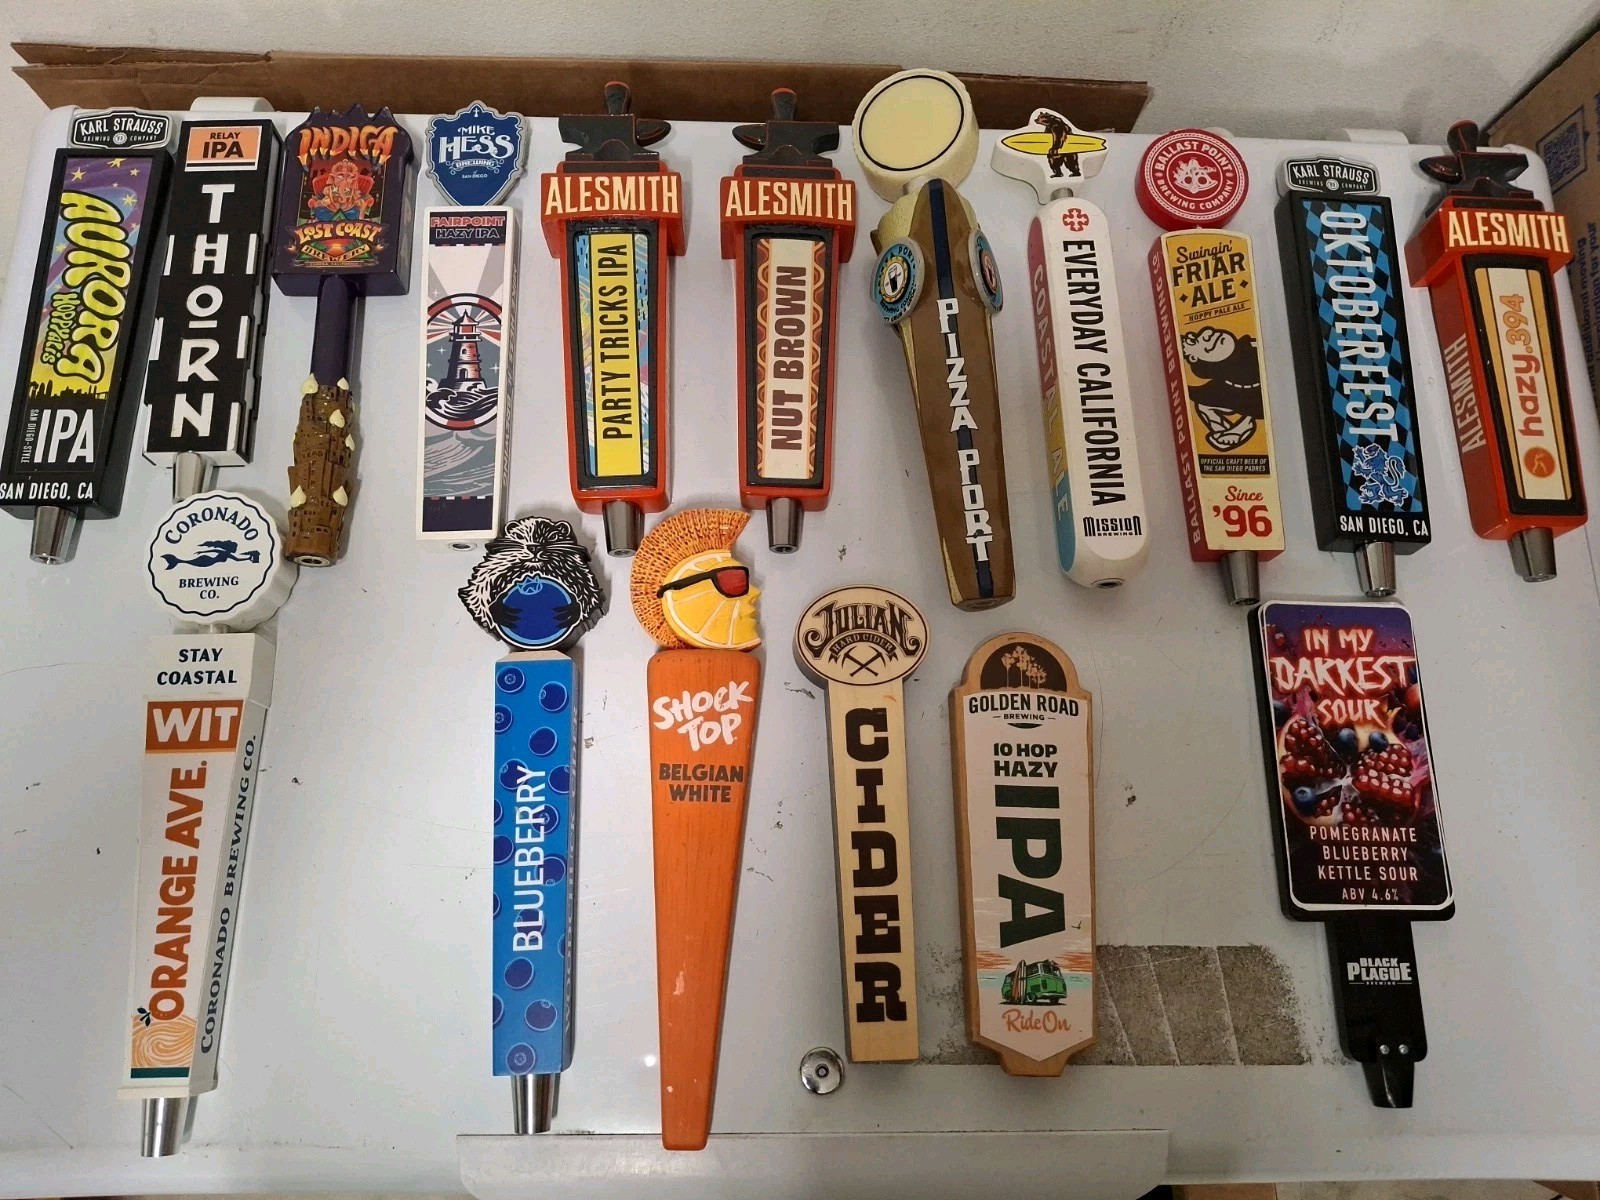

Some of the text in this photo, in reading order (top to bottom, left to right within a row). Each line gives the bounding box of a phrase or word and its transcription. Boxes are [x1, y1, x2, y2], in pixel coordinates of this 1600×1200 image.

[80, 117, 164, 136] KARL STRAUSS
[210, 131, 241, 140] RELAY
[458, 125, 496, 136] MIKE
[202, 141, 244, 159] IPA
[438, 134, 515, 164] HESS
[1154, 141, 1232, 171] BALLAST POINT
[1292, 164, 1370, 185] KARL STRAUSS
[544, 175, 679, 215] ALESMITH
[724, 180, 853, 221] ALESMITH
[1157, 179, 1234, 210] BREWING COMPANY
[294, 222, 383, 244] LOST COAST
[430, 216, 506, 228] FAIRPOINT
[435, 228, 501, 239] HAZY IPA
[1448, 210, 1570, 254] ALESMITH
[302, 244, 369, 261] BREWERY
[597, 244, 628, 277] IPA
[1171, 252, 1246, 287] FRIAR
[1191, 278, 1237, 308] ALE
[171, 183, 236, 438] THORN
[598, 284, 631, 359] TRICKS
[1156, 276, 1176, 373] BREWING
[1189, 302, 1246, 322] HOPPY PALE ALE
[1320, 210, 1399, 441] OKTOBERFEST
[770, 265, 807, 451] NUT BROWN
[1062, 239, 1126, 506] EVERYDAY CALIFORNIA
[1033, 263, 1070, 514] COASTAL ALE
[1444, 332, 1487, 454] ALESMITH
[600, 371, 633, 440] PARTY
[1170, 379, 1186, 444] POINT
[33, 408, 95, 463] IPA
[936, 297, 993, 561] PIZZA PORT
[1200, 458, 1223, 466] OFFICIAL
[1226, 458, 1243, 466] CRAFT
[0, 481, 94, 500] SAN DIEGO, CA
[1180, 451, 1201, 544] BALLAST
[1225, 485, 1264, 502] Since
[165, 506, 259, 545] CORONADO
[1082, 515, 1142, 537] MISSION
[1340, 515, 1429, 536] SAN DIEGO, CA
[178, 576, 240, 589] BREWING
[199, 589, 220, 600] CO.
[802, 600, 923, 660] JULIAN
[832, 634, 893, 652] HARD CIDER
[1304, 629, 1374, 657] IN MY
[178, 648, 224, 663] STAY
[156, 669, 238, 686] COASTAL
[1269, 656, 1418, 696] DARKEST
[652, 680, 754, 730] SHOCK
[968, 694, 1079, 717] GOLDEN ROAD
[1003, 713, 1045, 721] BREWING
[1317, 699, 1387, 728] SOUR
[152, 706, 240, 743] WIT
[677, 712, 742, 752] TOP
[1016, 743, 1058, 758] HOP
[659, 763, 744, 783] BELGIAN
[994, 760, 1059, 778] HAZY
[668, 784, 732, 803] WHITE
[1309, 825, 1417, 842] POMEGRANATE
[512, 765, 546, 952] BLUEBERRY
[845, 707, 908, 1023] CIDER
[994, 784, 1066, 949] IPA
[1322, 845, 1408, 861] BLUEBERRY
[1317, 865, 1418, 881] KETTLE SOUR
[148, 760, 208, 1021] ORANGE AVE.
[200, 735, 257, 1054] CORONADO BREWING CO.
[1342, 887, 1399, 901] ABV 4.6%
[1346, 962, 1412, 981] PLAGUE
[1359, 957, 1398, 967] BLACK
[1002, 1008, 1072, 1034] Ride On
